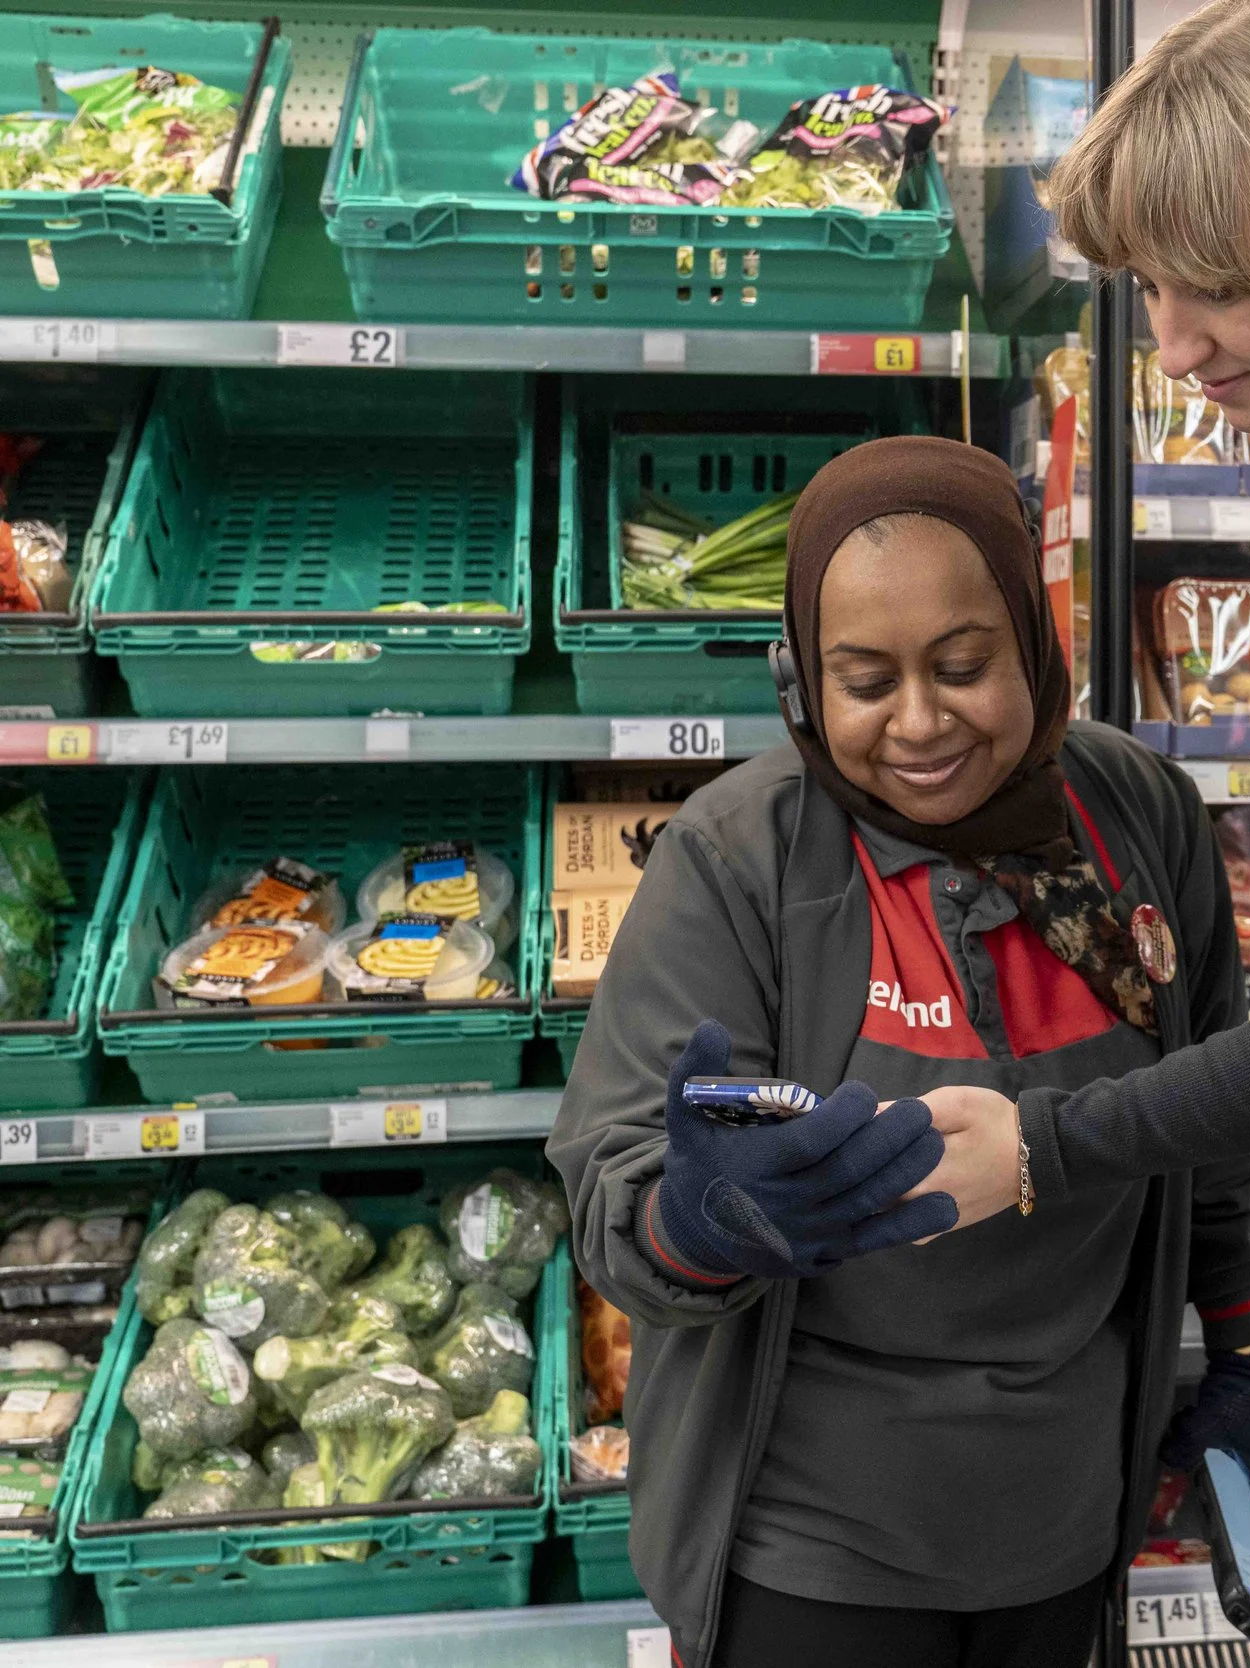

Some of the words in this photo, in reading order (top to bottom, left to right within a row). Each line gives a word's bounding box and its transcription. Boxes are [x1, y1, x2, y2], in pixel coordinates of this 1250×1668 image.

[33, 324, 96, 357] £1.40
[350, 330, 391, 363] £2
[886, 349, 905, 366] £1
[60, 736, 79, 755] £1
[168, 725, 224, 760] £1.69
[669, 722, 721, 755] 80p
[565, 828, 579, 873] DATES
[580, 813, 595, 874] JORDAN
[580, 915, 594, 962] DATES
[1136, 1596, 1197, 1638] £1.45
